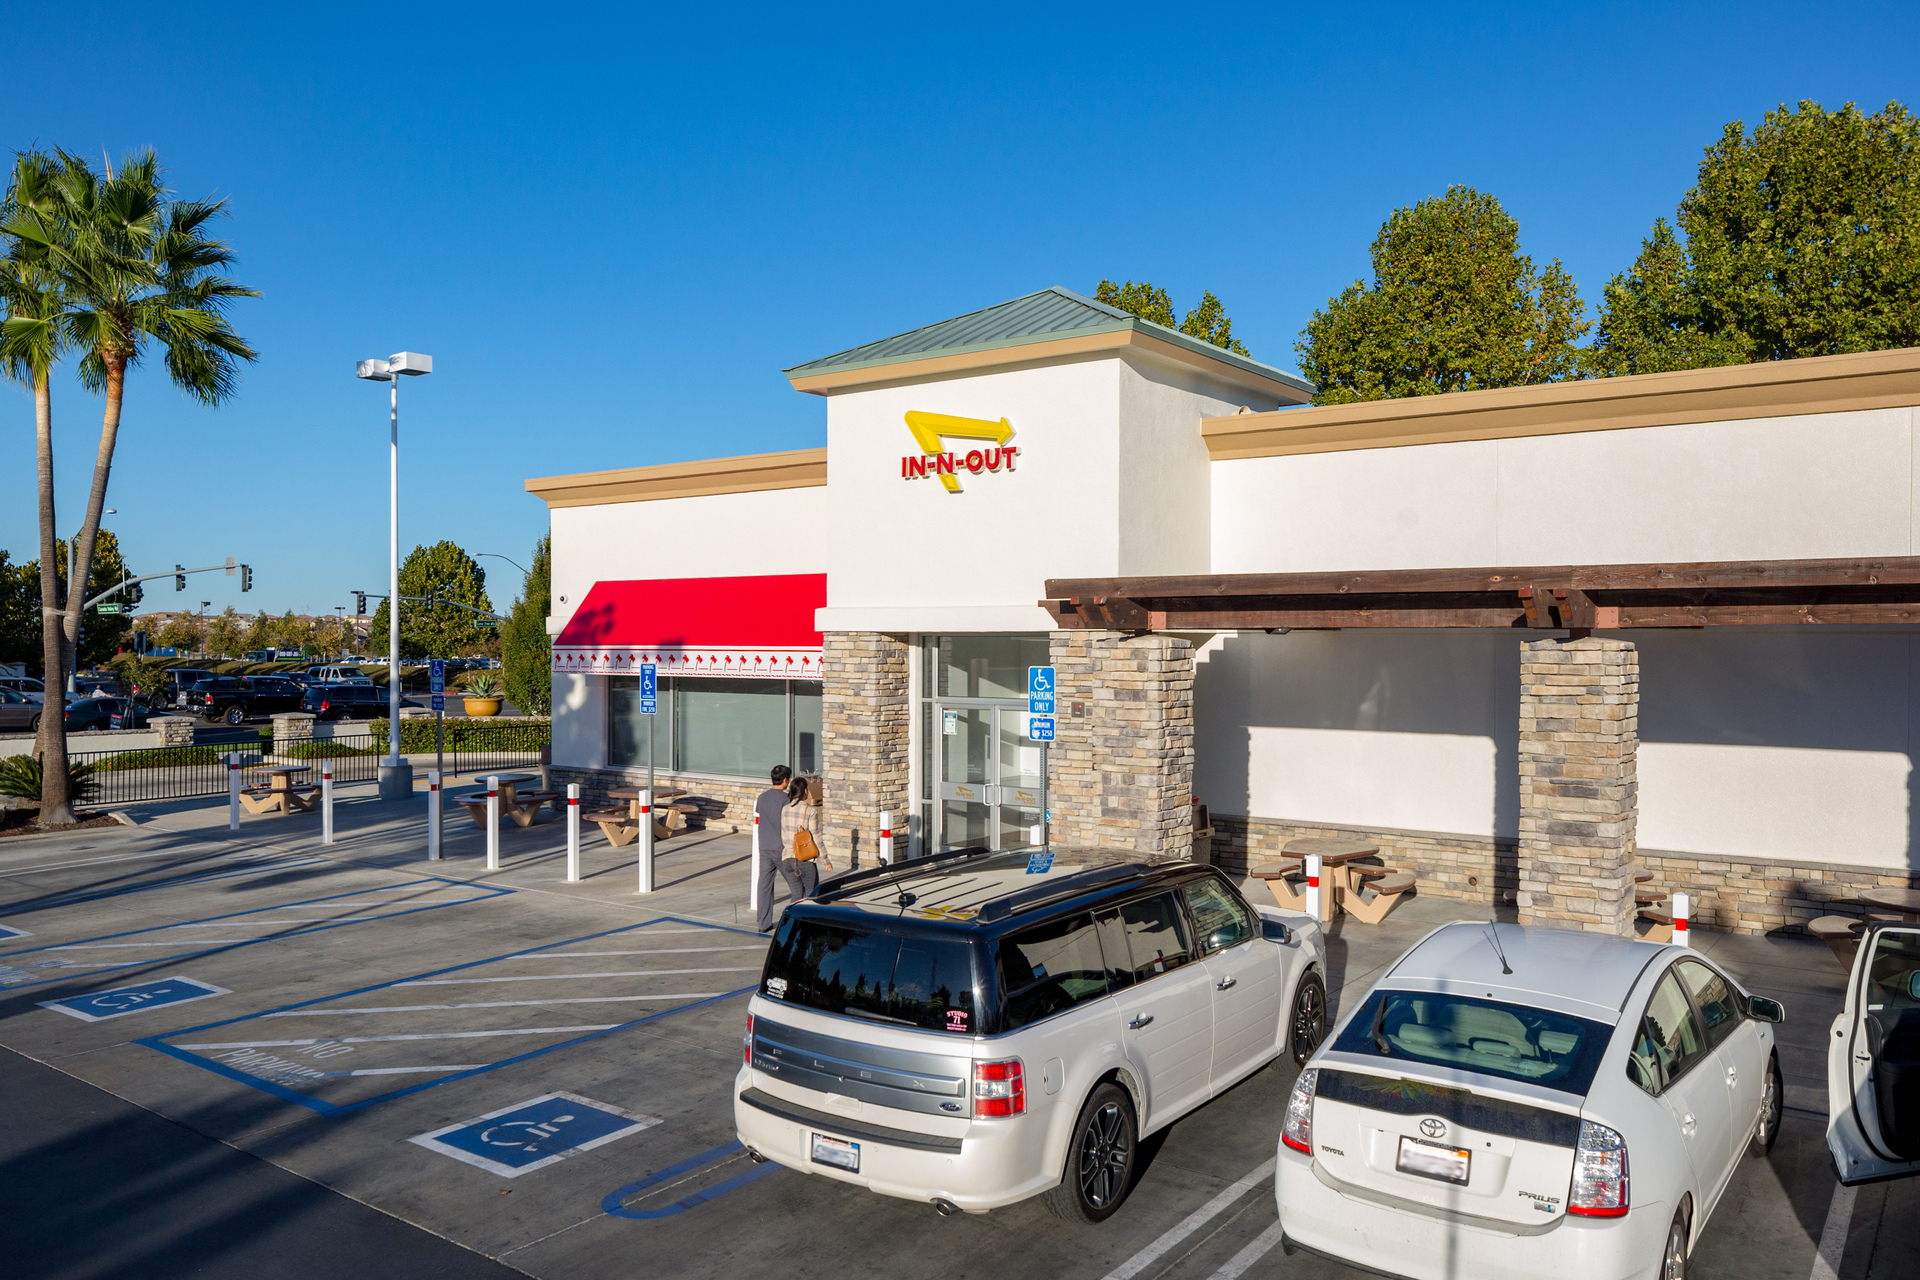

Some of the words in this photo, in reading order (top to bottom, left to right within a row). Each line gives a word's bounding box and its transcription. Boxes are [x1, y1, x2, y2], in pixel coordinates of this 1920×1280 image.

[901, 446, 1019, 479] IN-N-OUT
[1030, 690, 1054, 701] PARKING
[1034, 701, 1050, 711] ONLY
[1041, 729, 1053, 737] $250
[946, 1010, 968, 1018] STUDIO
[953, 1015, 961, 1024] 71
[772, 1048, 926, 1089] FLEX
[1320, 1145, 1345, 1157] TOYOTA
[1518, 1190, 1560, 1204] PRIUS
